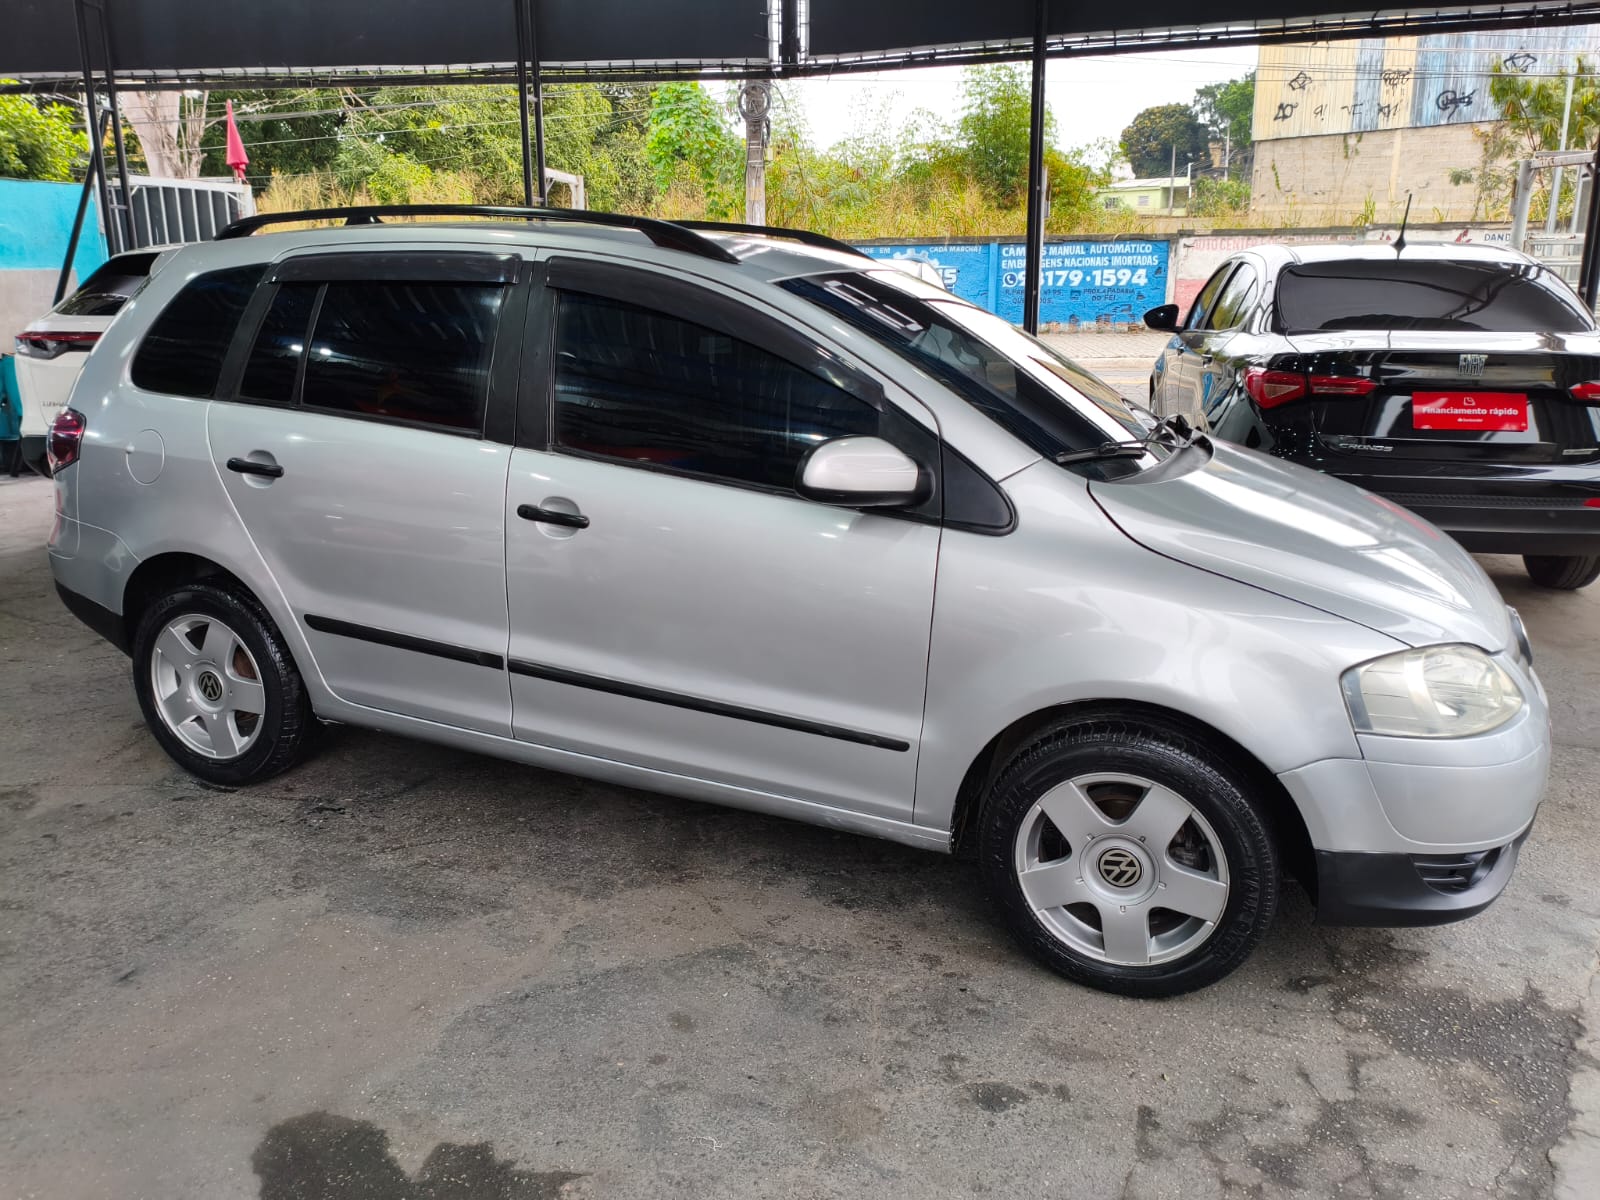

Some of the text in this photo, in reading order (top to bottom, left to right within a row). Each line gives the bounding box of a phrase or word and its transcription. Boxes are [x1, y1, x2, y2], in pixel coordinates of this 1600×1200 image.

[1049, 244, 1086, 256] MANUAL
[1090, 241, 1153, 254] AUTOMÁTICO
[1064, 256, 1109, 267] NACIONAIS
[1112, 255, 1159, 266] IMORTADAS
[1422, 406, 1519, 417] Financiamento rápido
[1339, 443, 1394, 452] CRONOS
